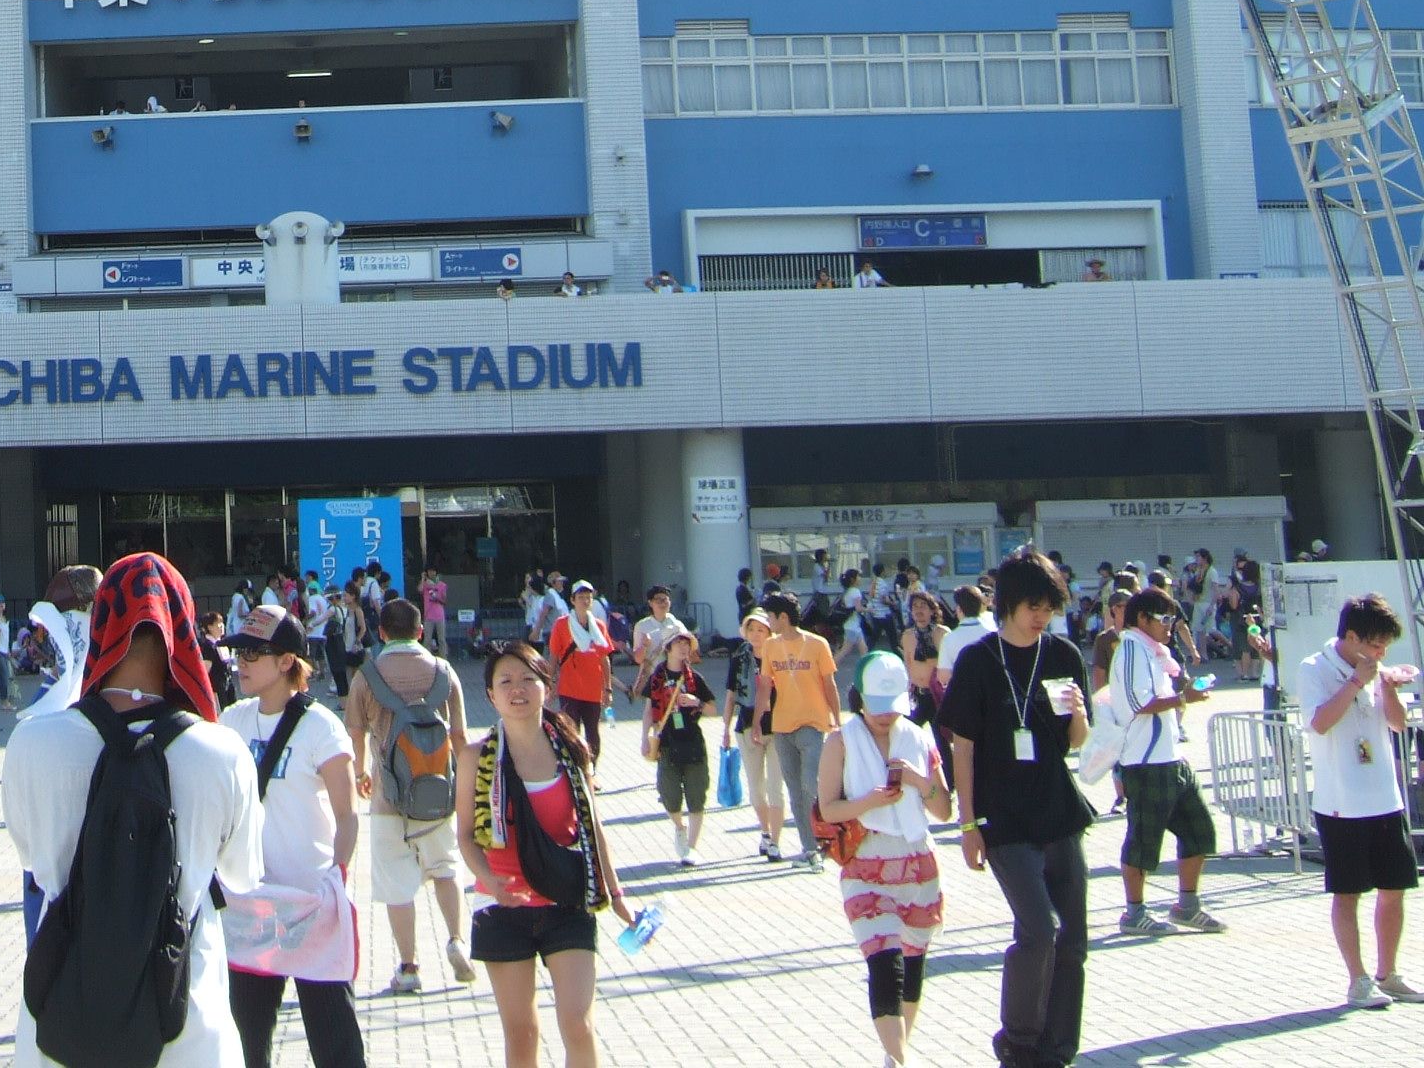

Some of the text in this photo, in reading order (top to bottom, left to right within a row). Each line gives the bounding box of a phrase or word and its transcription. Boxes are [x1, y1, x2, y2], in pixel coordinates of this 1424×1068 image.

[916, 219, 930, 237] C
[168, 349, 376, 401] MARINE
[401, 341, 642, 394] STADIUM
